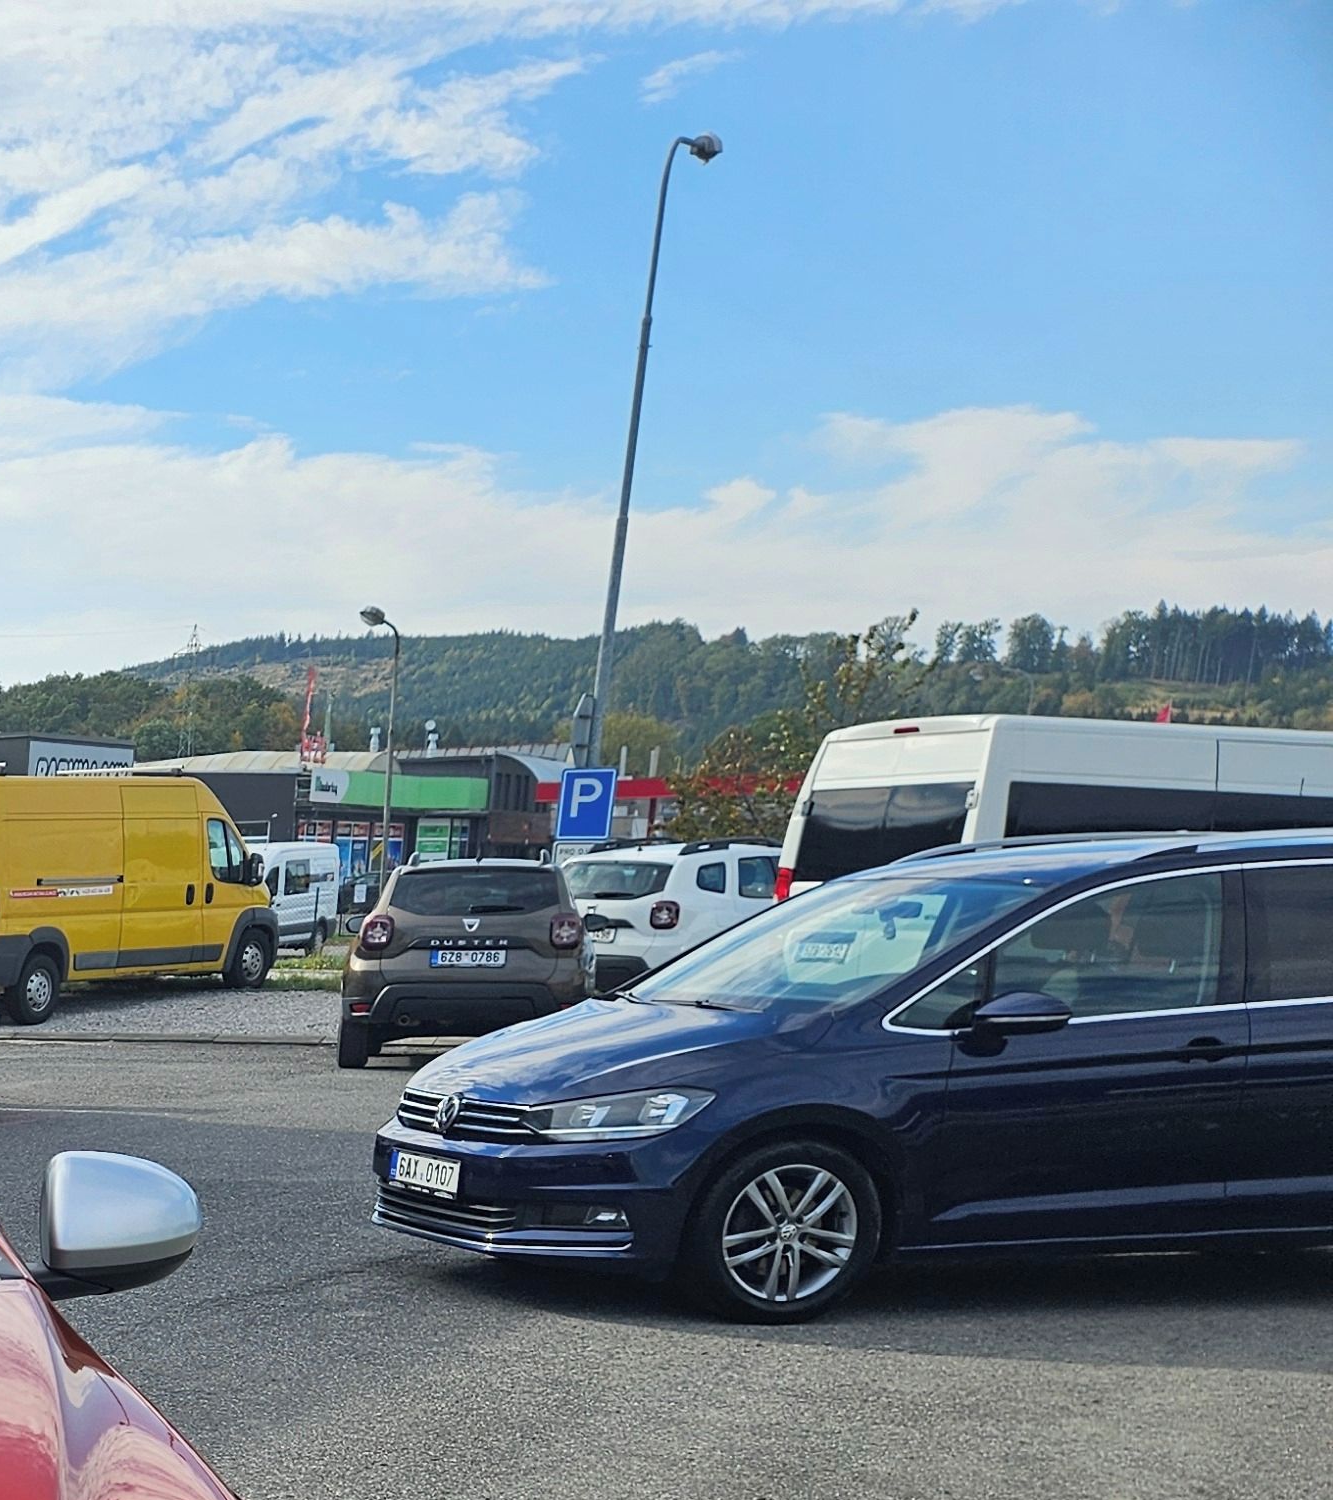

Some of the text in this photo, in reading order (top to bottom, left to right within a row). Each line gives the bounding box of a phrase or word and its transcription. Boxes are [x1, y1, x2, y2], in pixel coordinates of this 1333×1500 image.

[570, 778, 603, 818] P
[440, 951, 500, 963] 6Z8 0786
[398, 1156, 455, 1187] 6AX 0107
